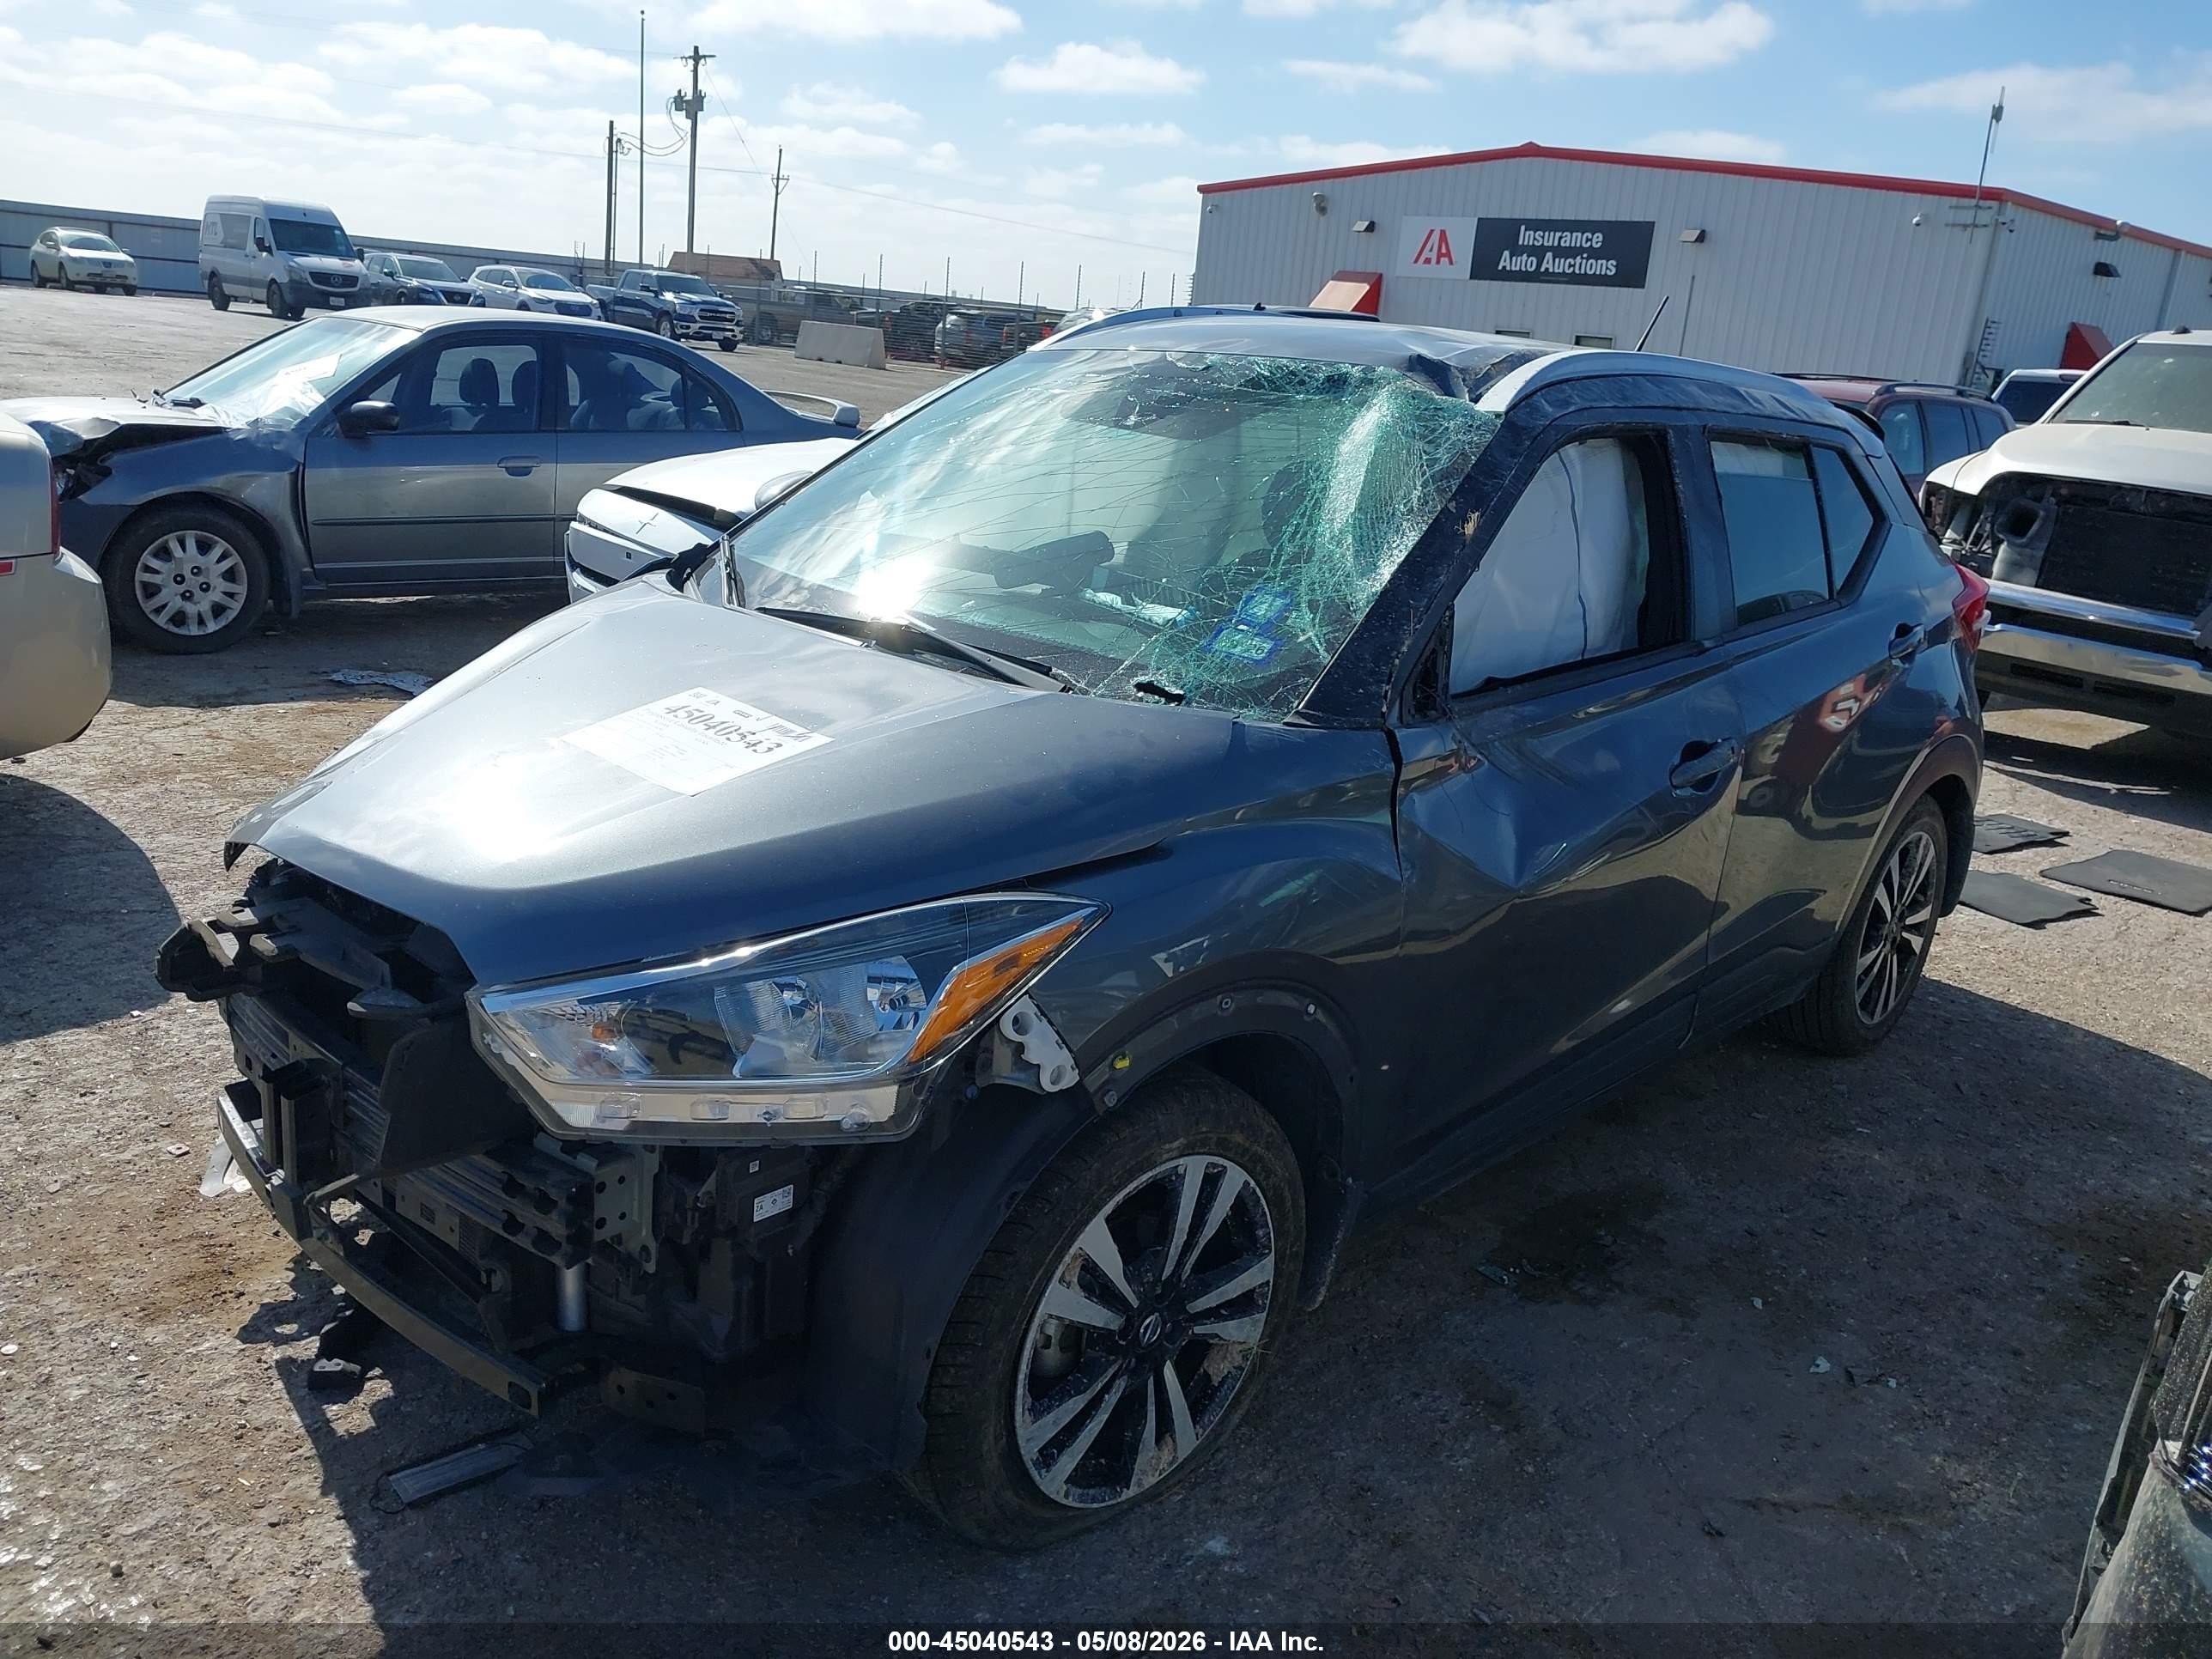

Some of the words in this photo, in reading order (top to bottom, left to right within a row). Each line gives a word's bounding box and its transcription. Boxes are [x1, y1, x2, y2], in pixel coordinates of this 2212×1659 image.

[1518, 224, 1603, 248] Insurance
[1497, 250, 1537, 272] Auto
[1540, 252, 1618, 276] Auctions
[663, 703, 784, 754] 45040543
